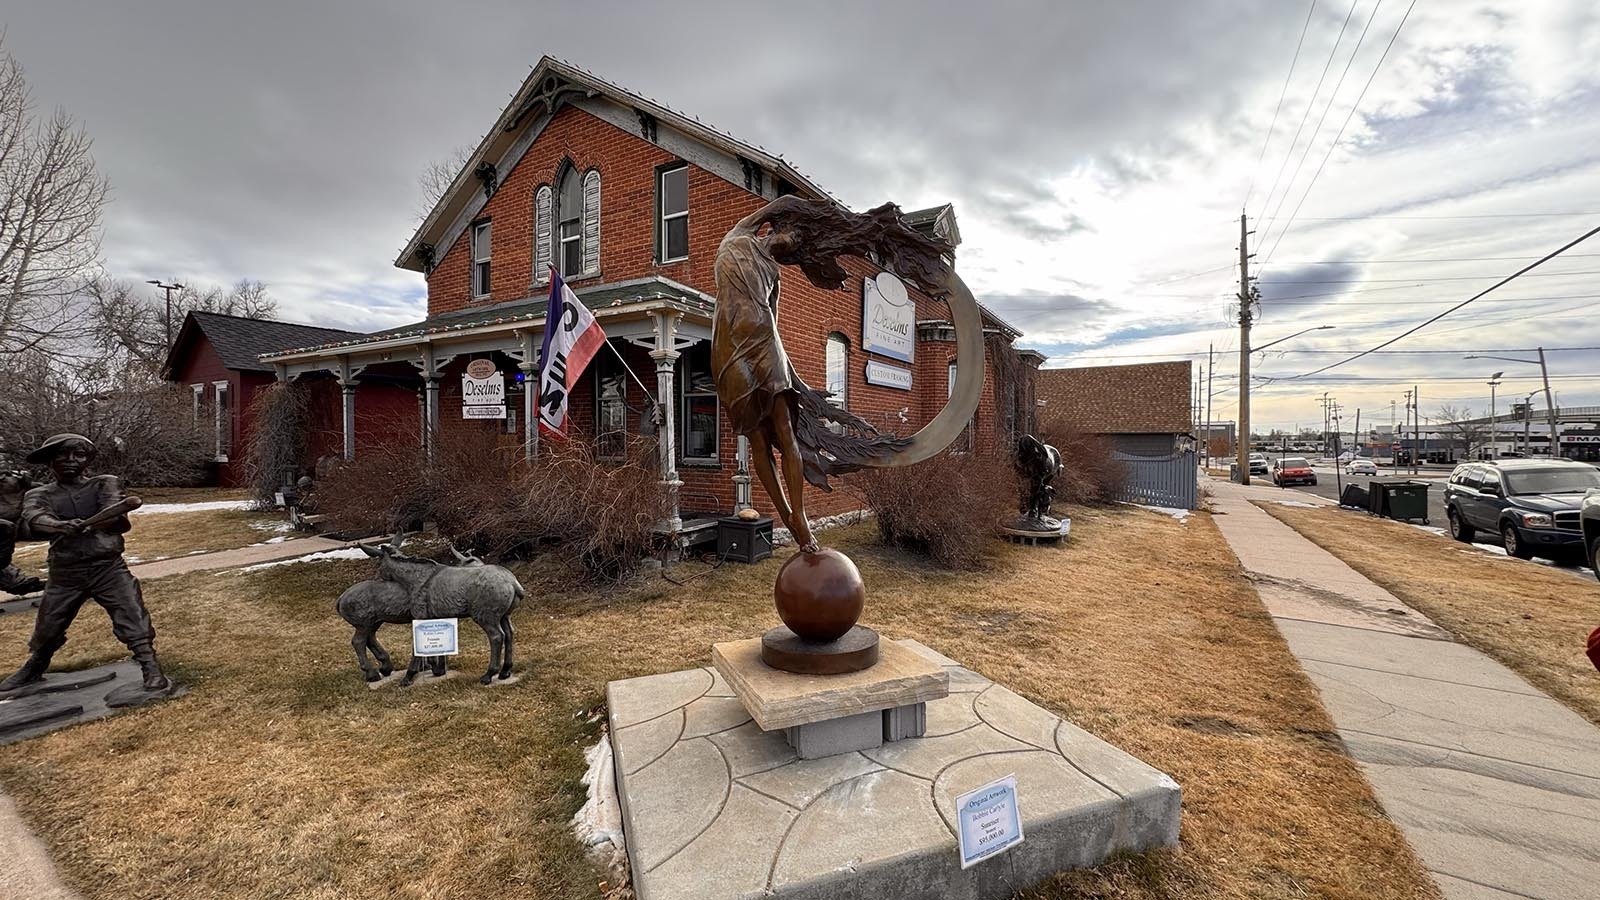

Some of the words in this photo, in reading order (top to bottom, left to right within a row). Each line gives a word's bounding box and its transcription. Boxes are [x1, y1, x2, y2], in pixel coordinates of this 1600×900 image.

[465, 380, 501, 397] Deselms
[969, 795, 988, 808] Original
[989, 788, 1007, 800] Artwork
